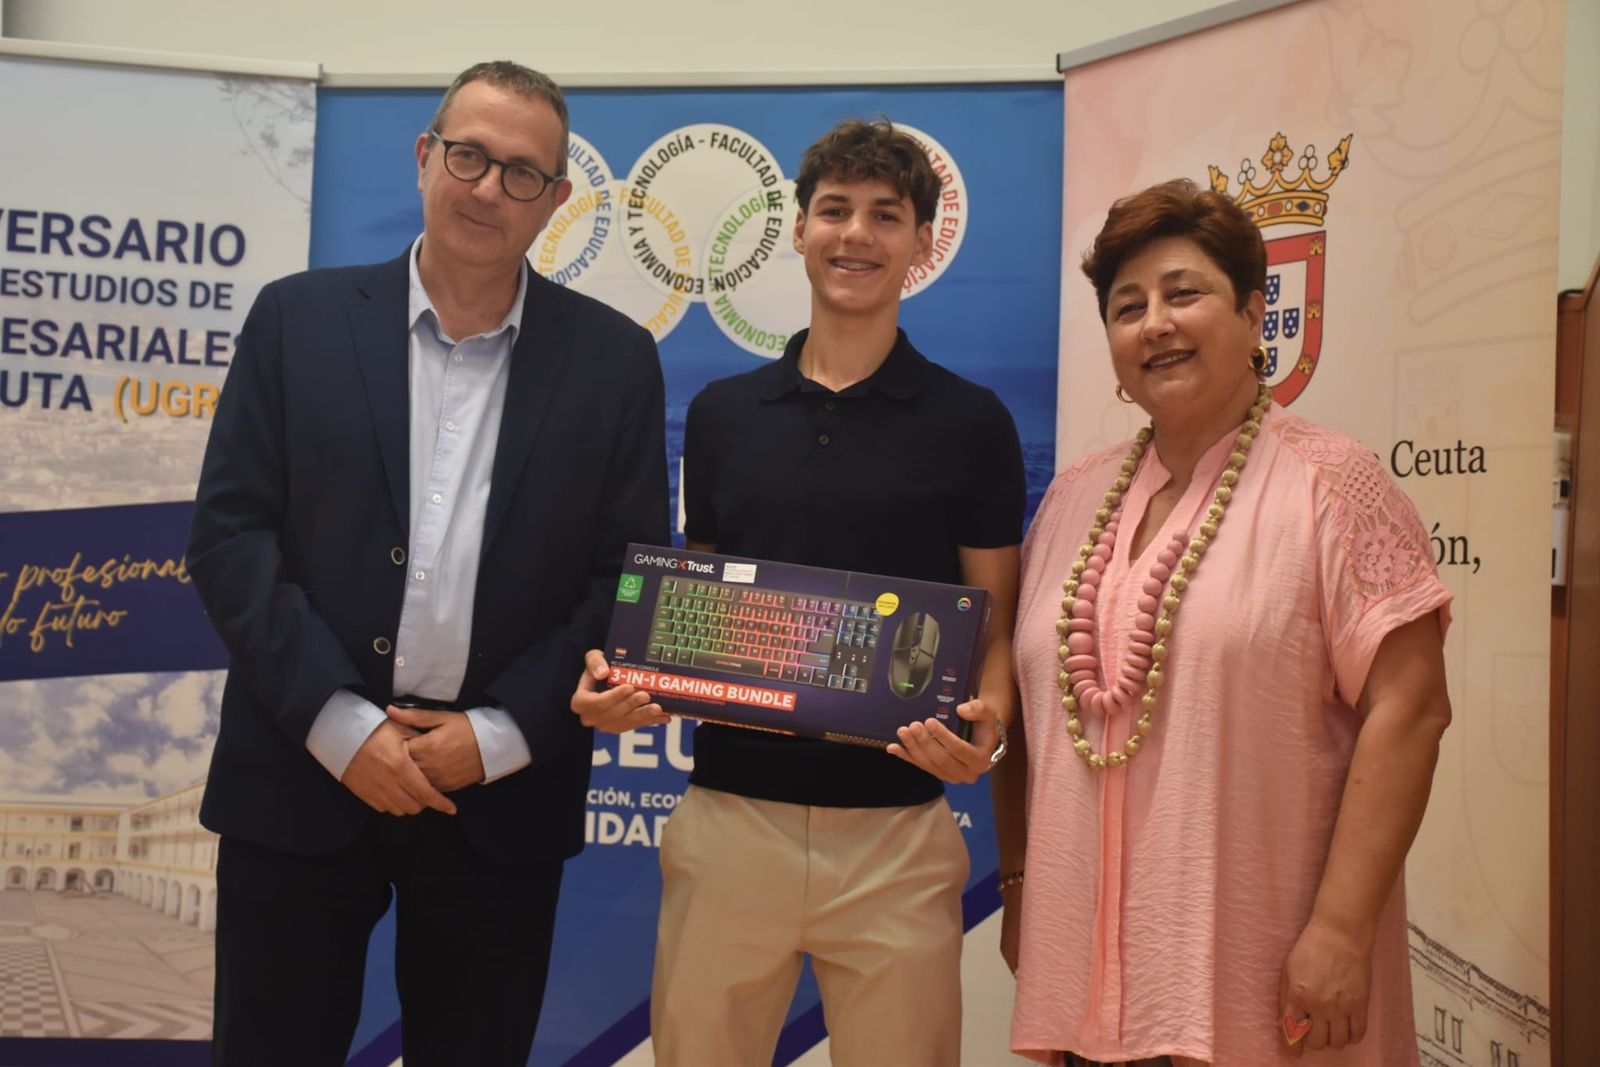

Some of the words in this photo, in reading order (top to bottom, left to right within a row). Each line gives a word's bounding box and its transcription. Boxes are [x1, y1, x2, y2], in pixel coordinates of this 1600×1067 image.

[627, 134, 695, 220] TECNOLOGÍA
[710, 132, 777, 188] FACULTAD
[766, 190, 783, 212] DE
[942, 189, 959, 213] DE
[0, 209, 246, 267] ERSARIO
[628, 226, 644, 236] Y
[633, 237, 704, 294] ECONOMÍA
[674, 245, 691, 268] DE
[0, 268, 178, 307] ESTUDIOS
[189, 281, 233, 310] DE
[2, 317, 242, 367] ESARIALE
[0, 370, 92, 411] UTA
[113, 376, 220, 423] (UGR
[1390, 439, 1487, 478] Ceuta
[634, 553, 678, 568] GAMING
[687, 561, 714, 574] Trust
[29, 595, 127, 652] futuro
[611, 668, 656, 687] 3-IN-1
[659, 676, 724, 697] GAMING
[727, 687, 794, 708] BUNDLE
